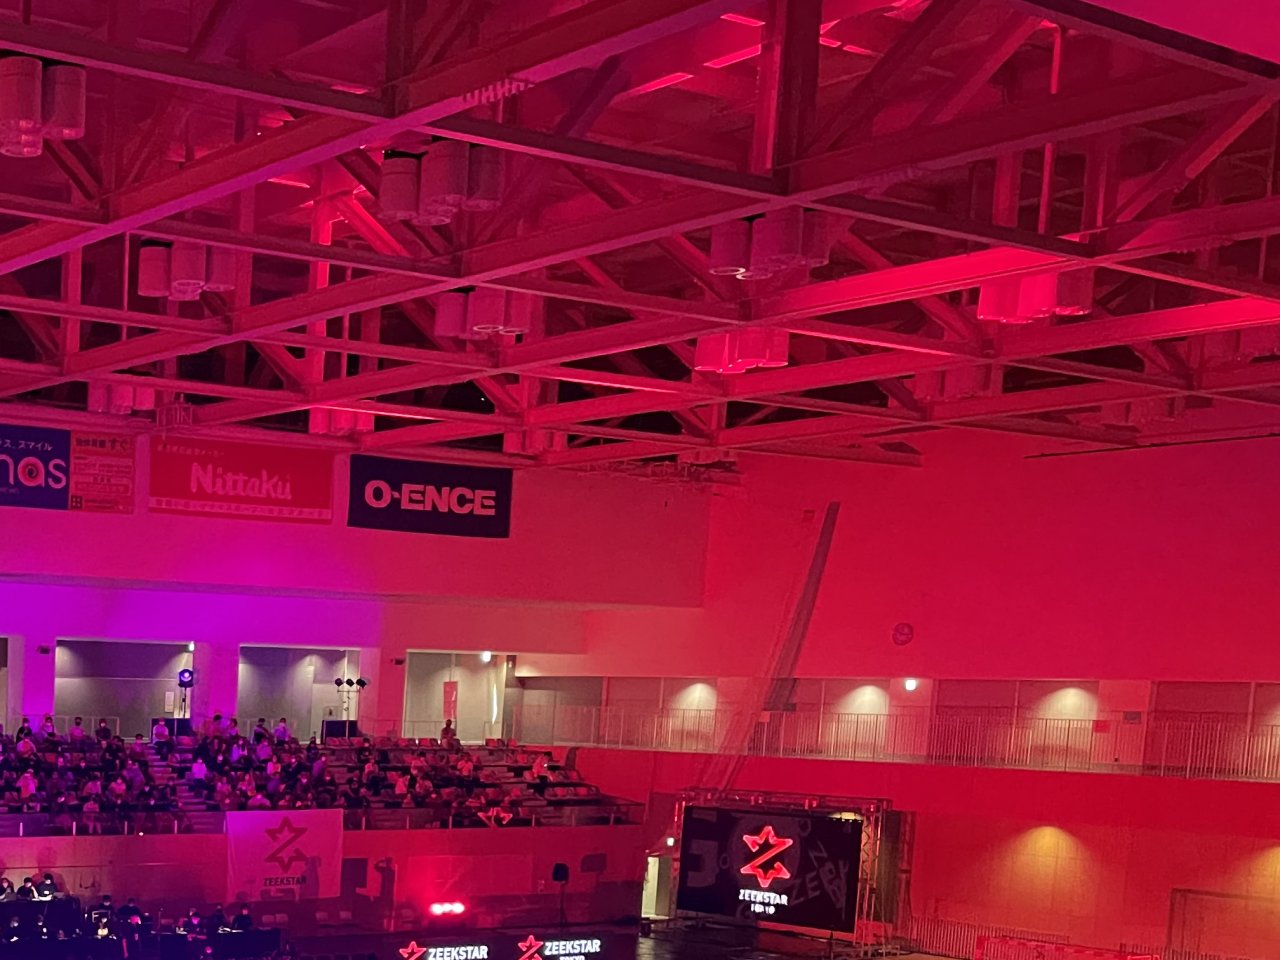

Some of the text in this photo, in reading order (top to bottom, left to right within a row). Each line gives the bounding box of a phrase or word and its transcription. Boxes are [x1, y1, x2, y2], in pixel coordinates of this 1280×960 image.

[190, 461, 293, 500] Nittaku
[364, 479, 497, 516] O-ENCE
[738, 888, 789, 906] ZEEKSTAR
[545, 938, 601, 956] ZEEKSTAR
